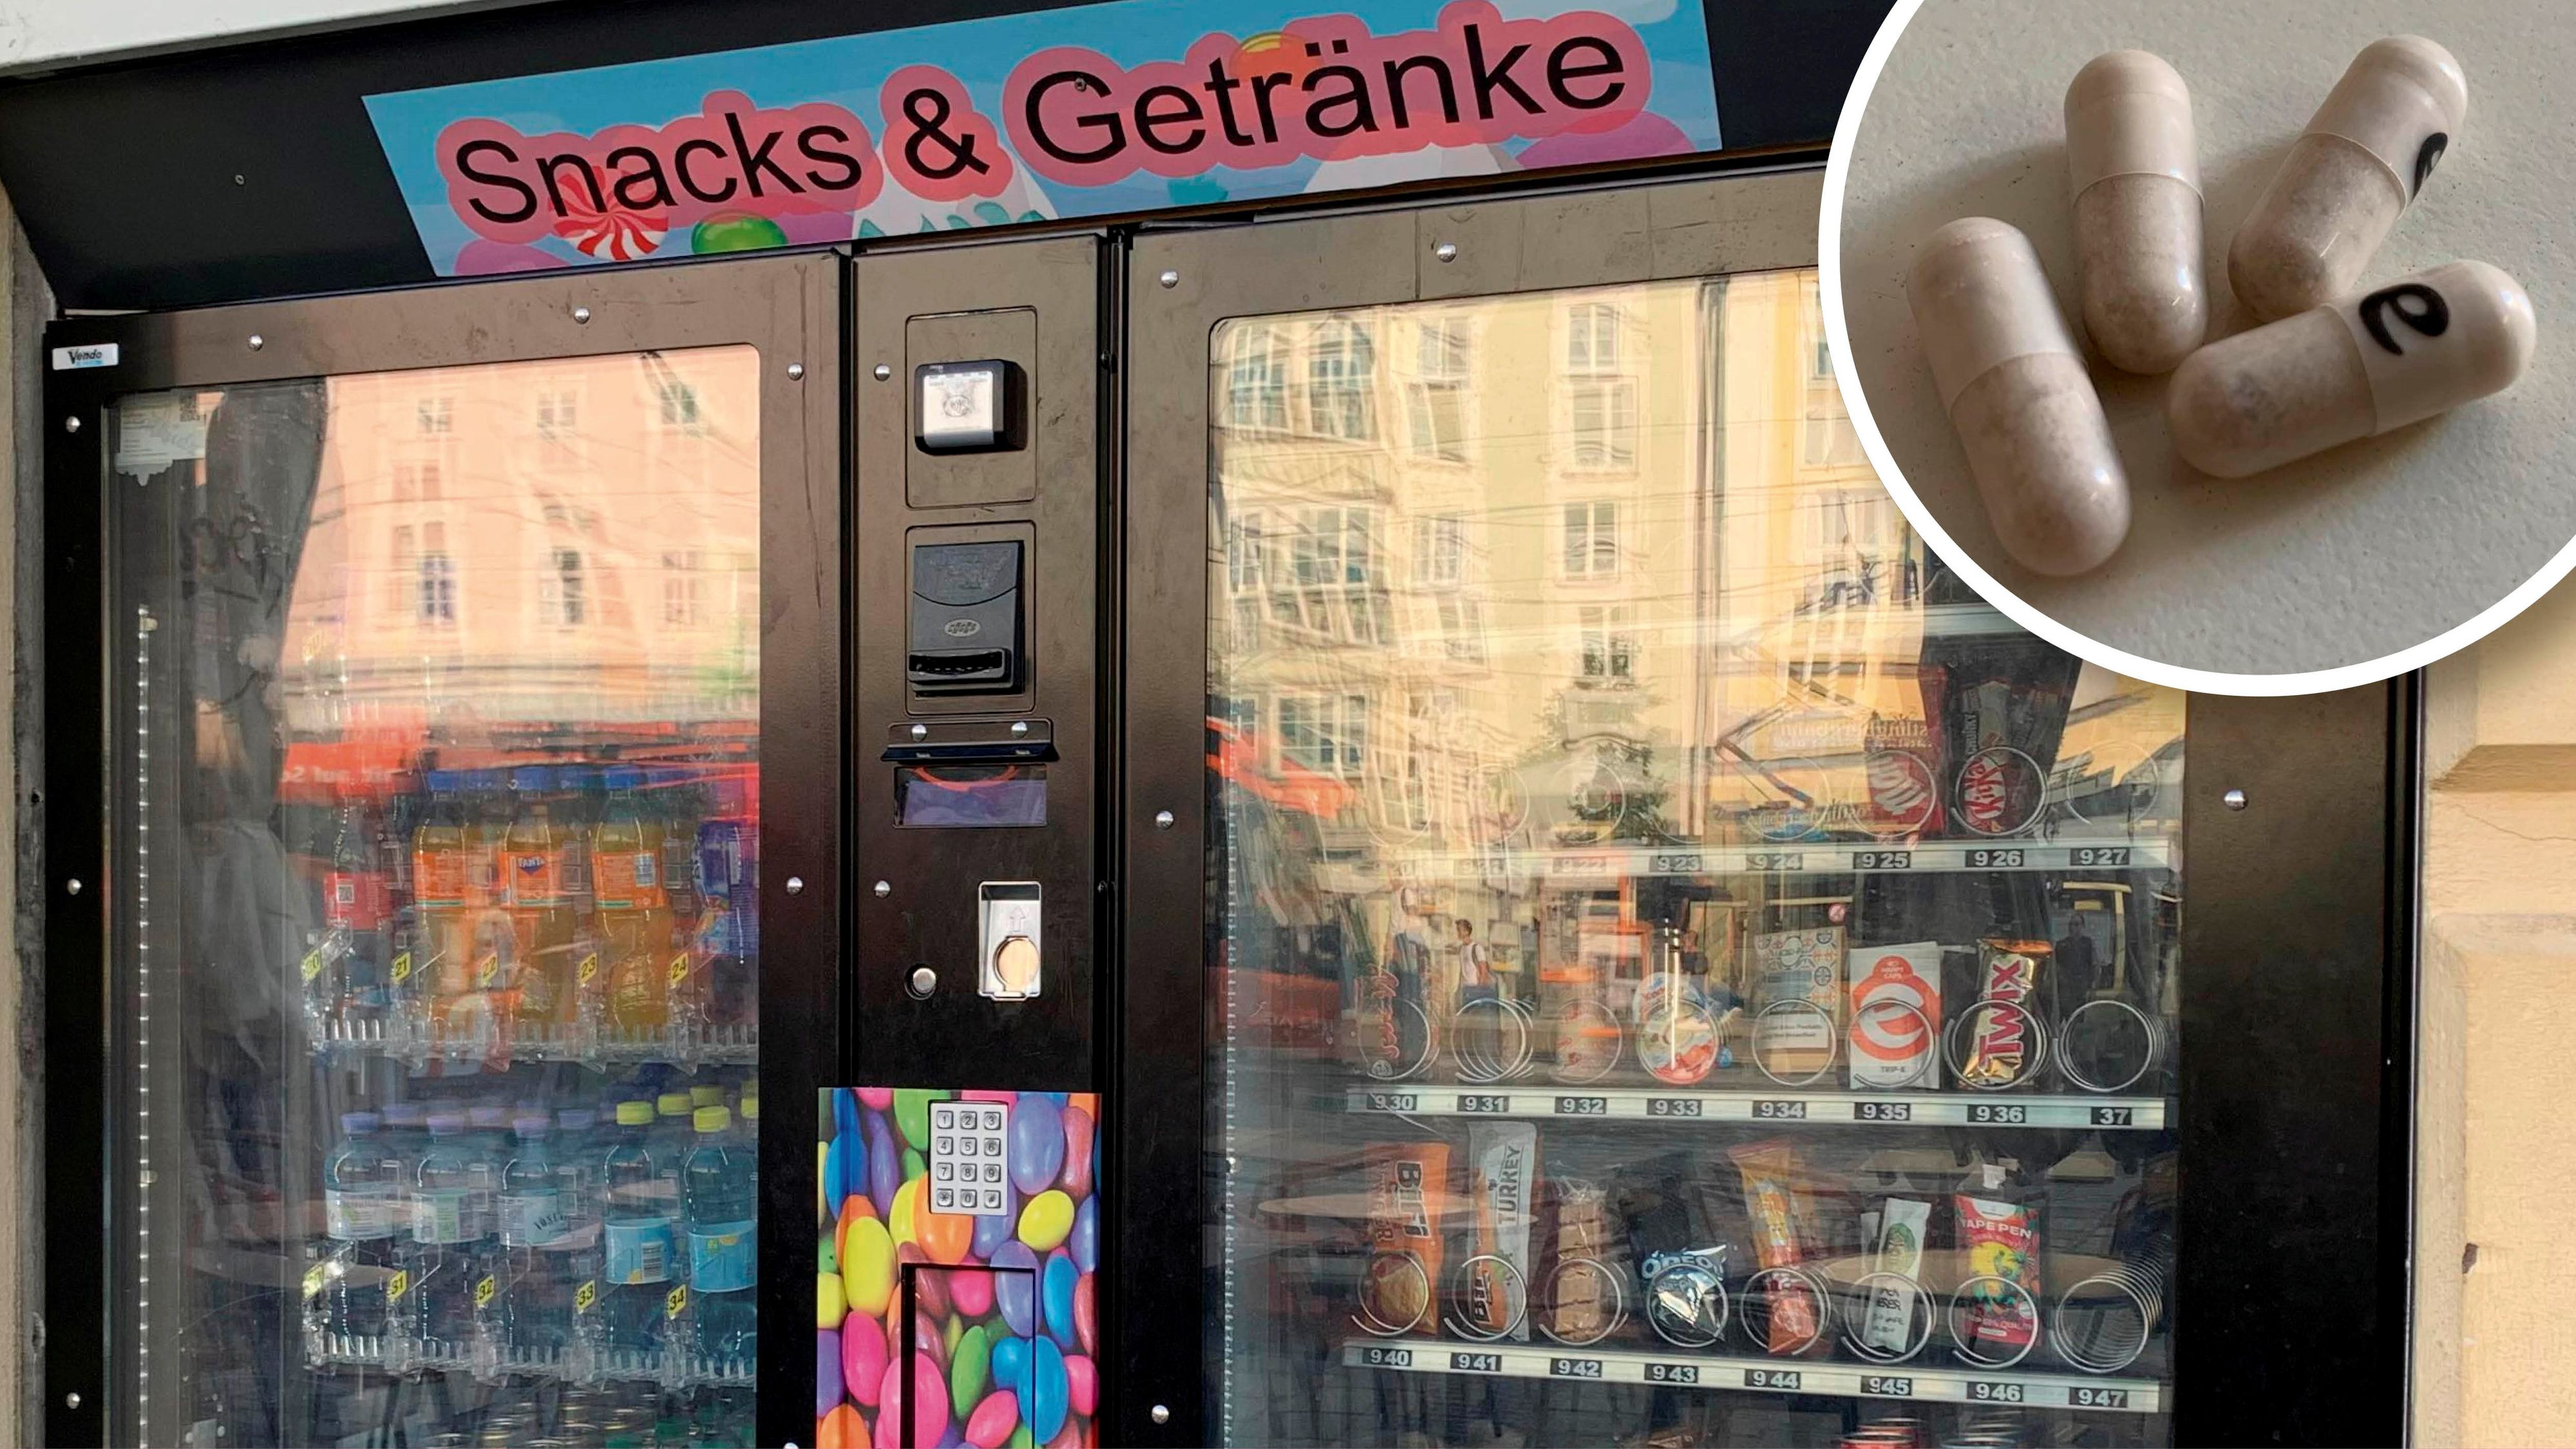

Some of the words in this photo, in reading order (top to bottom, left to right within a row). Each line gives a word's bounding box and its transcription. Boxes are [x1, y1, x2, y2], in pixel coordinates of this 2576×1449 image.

[456, 111, 862, 224] Snacks
[902, 88, 990, 181] &
[1025, 23, 1626, 164] Getränke
[2358, 283, 2451, 356] e
[67, 348, 103, 365] Vendo
[1657, 857, 1700, 871] 923
[1755, 856, 1801, 870] 924
[1861, 852, 1908, 867] 925
[1975, 851, 2022, 866] 926
[2079, 849, 2127, 865] 927
[395, 956, 408, 977] 21
[581, 956, 596, 979] 23
[671, 956, 687, 979] 24
[1978, 959, 2025, 1068] TWIX
[1374, 1095, 1414, 1111] 930
[1465, 1096, 1505, 1112] 931
[1563, 1097, 1604, 1113] 932
[1654, 1099, 1699, 1115] 933
[1761, 1102, 1803, 1117] 934
[1863, 1104, 1908, 1120] 935
[1976, 1106, 2023, 1122] 936
[2099, 1108, 2128, 1124] 37
[1495, 1144, 1523, 1224] TURKEY
[1998, 1222, 2032, 1239] PEN
[390, 1277, 404, 1295] 31
[478, 1278, 494, 1300] 32
[577, 1284, 594, 1306] 33
[669, 1288, 685, 1311] 34
[1370, 1349, 1409, 1365] 940
[1457, 1354, 1498, 1370] 941
[1558, 1359, 1599, 1376] 942
[1653, 1365, 1696, 1381] 943
[1752, 1372, 1797, 1388] 944
[1868, 1378, 1909, 1394] 945
[1975, 1383, 2022, 1401] 946
[2078, 1389, 2124, 1406] 947
